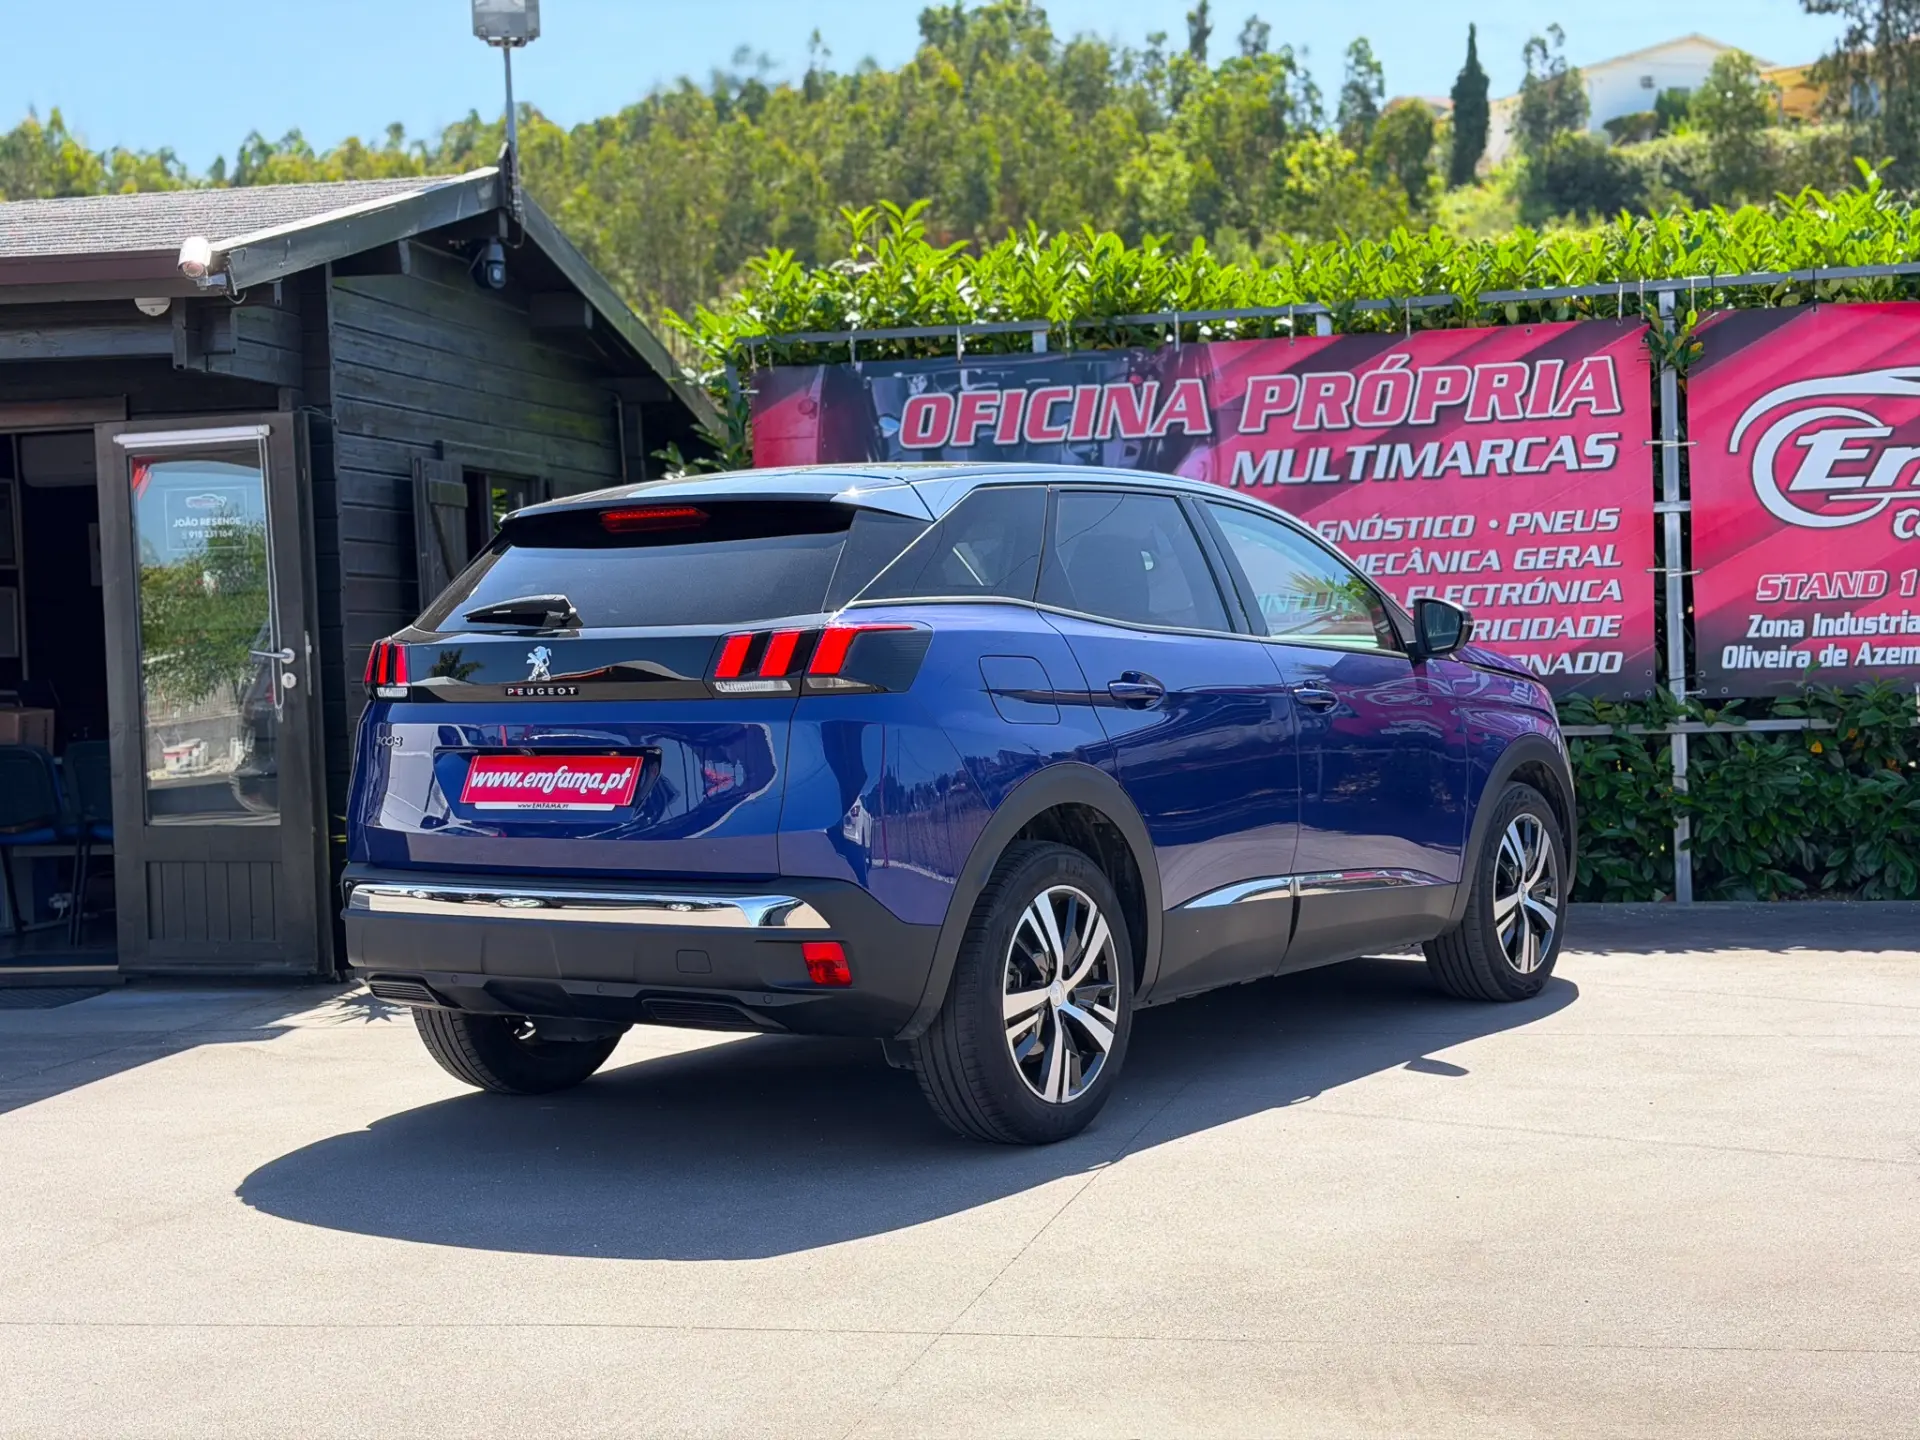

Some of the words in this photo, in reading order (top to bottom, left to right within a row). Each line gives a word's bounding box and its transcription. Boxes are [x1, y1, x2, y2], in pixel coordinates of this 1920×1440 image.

[899, 378, 1213, 449] OFICINA
[1238, 353, 1622, 434] PRÓPRIA
[1229, 431, 1620, 486] MULTIMARCAS
[172, 516, 199, 528] JOÃO
[199, 515, 242, 527] RESENDE
[1308, 513, 1475, 543] GNÓSTICO
[1505, 507, 1622, 536] PNEUS
[1512, 544, 1623, 571] GERAL
[1755, 569, 1889, 602] STAND
[1899, 568, 1918, 597] 1
[1470, 615, 1624, 642] RICIDADE
[1745, 613, 1805, 639] Zona
[1721, 644, 1811, 670] Oliveira
[1818, 643, 1849, 668] de
[506, 686, 577, 696] PEUGEOT
[470, 764, 633, 795] www.emfama.pt
